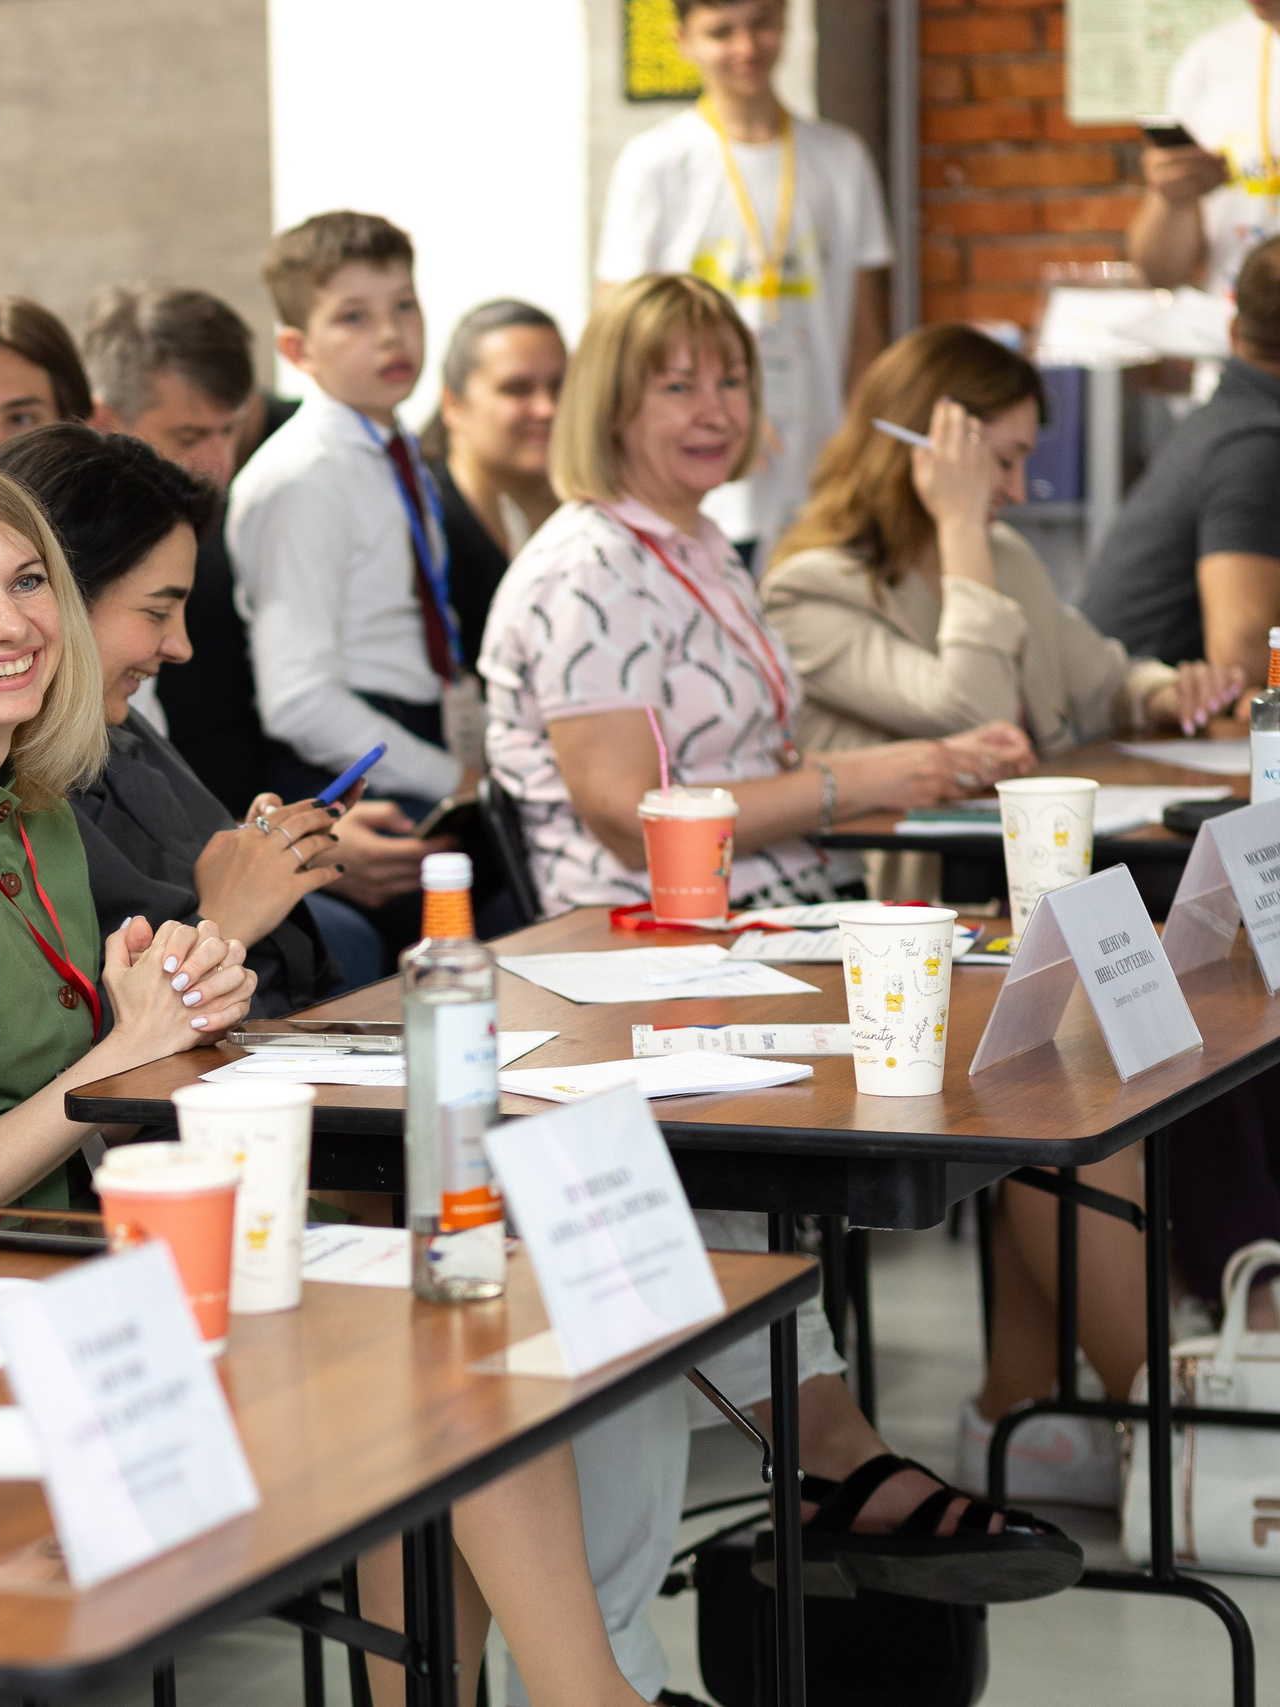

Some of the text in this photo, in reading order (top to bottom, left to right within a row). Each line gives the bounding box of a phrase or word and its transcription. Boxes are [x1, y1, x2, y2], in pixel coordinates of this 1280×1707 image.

[1098, 931, 1131, 955] ШЕНГОФ
[1094, 949, 1156, 985] ИННА СЕРГЕЕВНА
[855, 1005, 878, 1024] Rubin
[909, 1016, 931, 1053] startup
